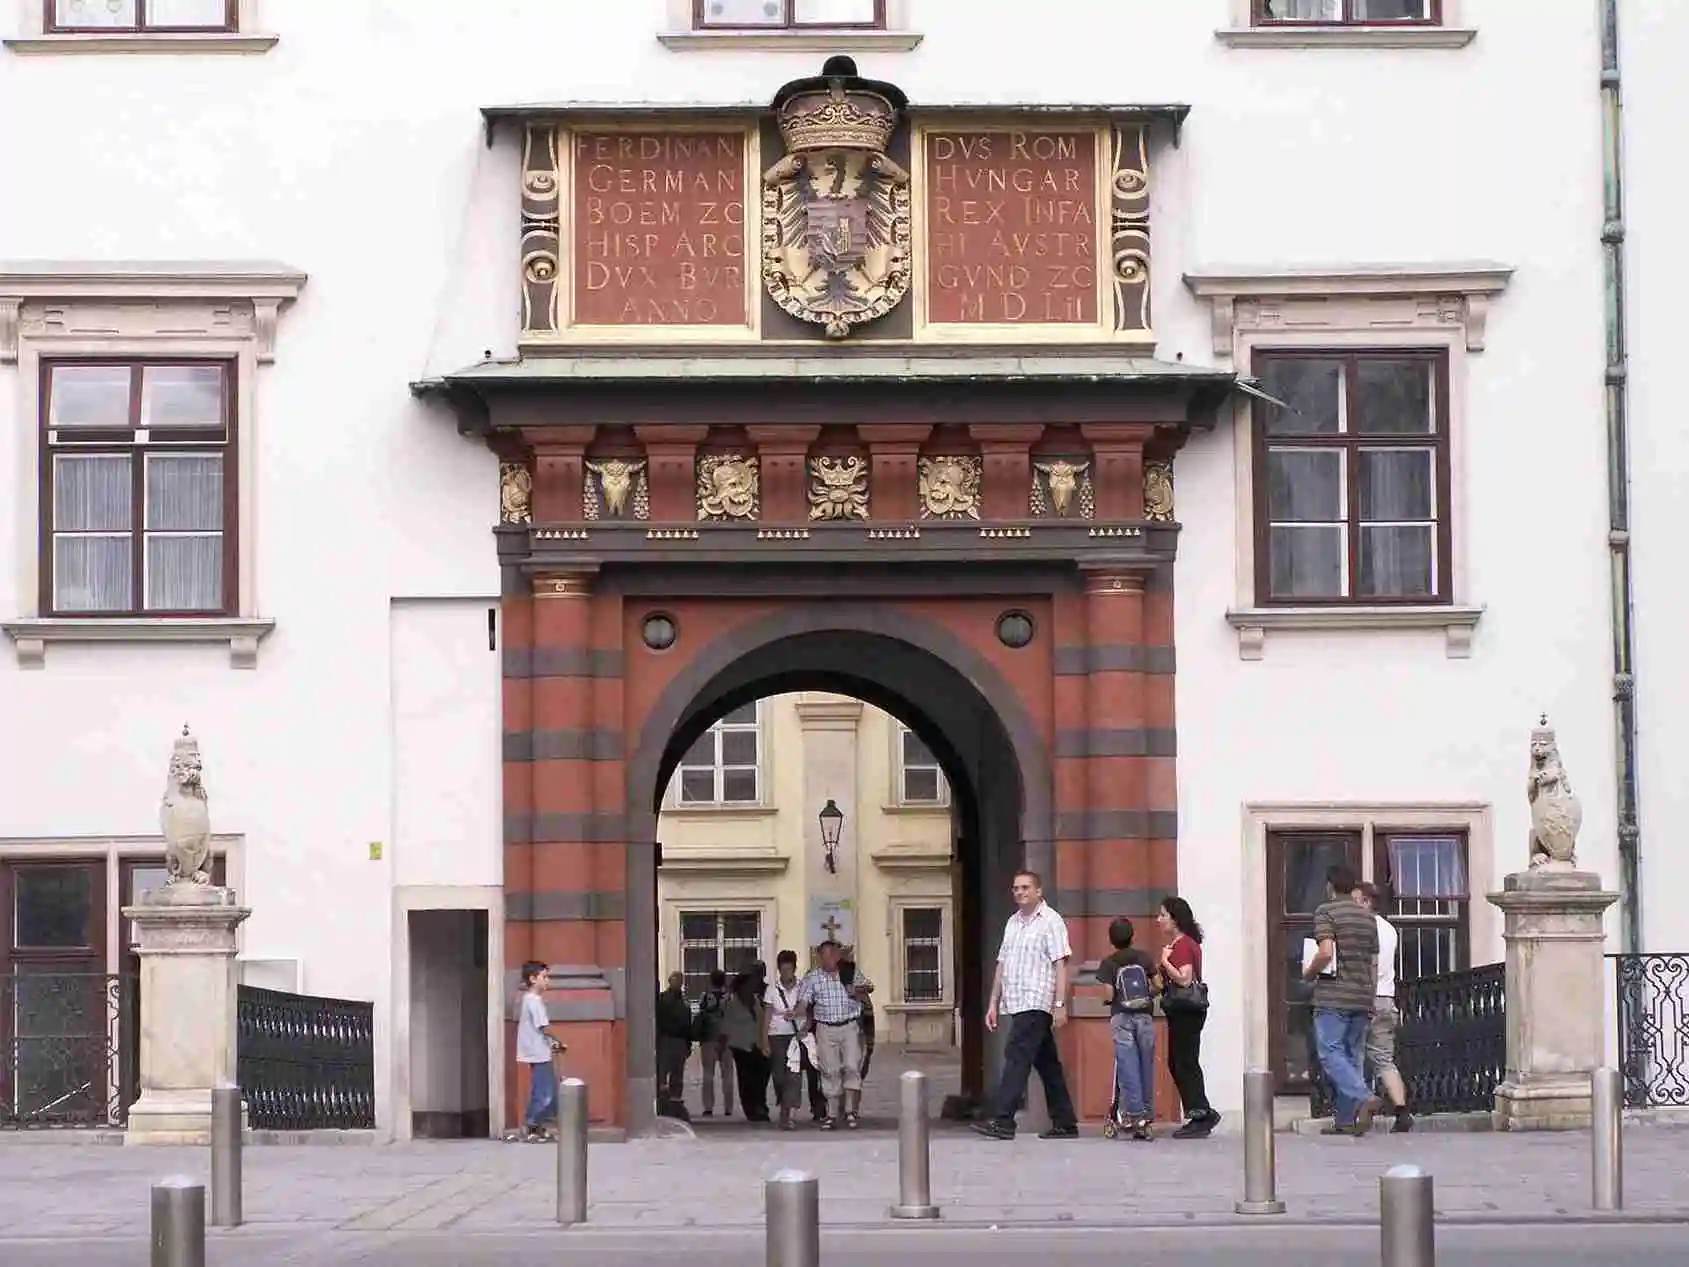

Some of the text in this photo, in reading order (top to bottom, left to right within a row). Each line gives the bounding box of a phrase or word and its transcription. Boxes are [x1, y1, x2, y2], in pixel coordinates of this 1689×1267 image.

[935, 132, 1076, 160] DVS ROM
[588, 164, 735, 194] GERMAN
[935, 165, 1080, 193] HVNGAR
[586, 197, 680, 225] BOEM
[935, 197, 1091, 225] REX INFA
[586, 230, 659, 257] HISP
[989, 229, 1090, 257] AVSTR
[586, 261, 657, 290] DVX
[937, 265, 1029, 290] GVND
[1000, 292, 1026, 321] D
